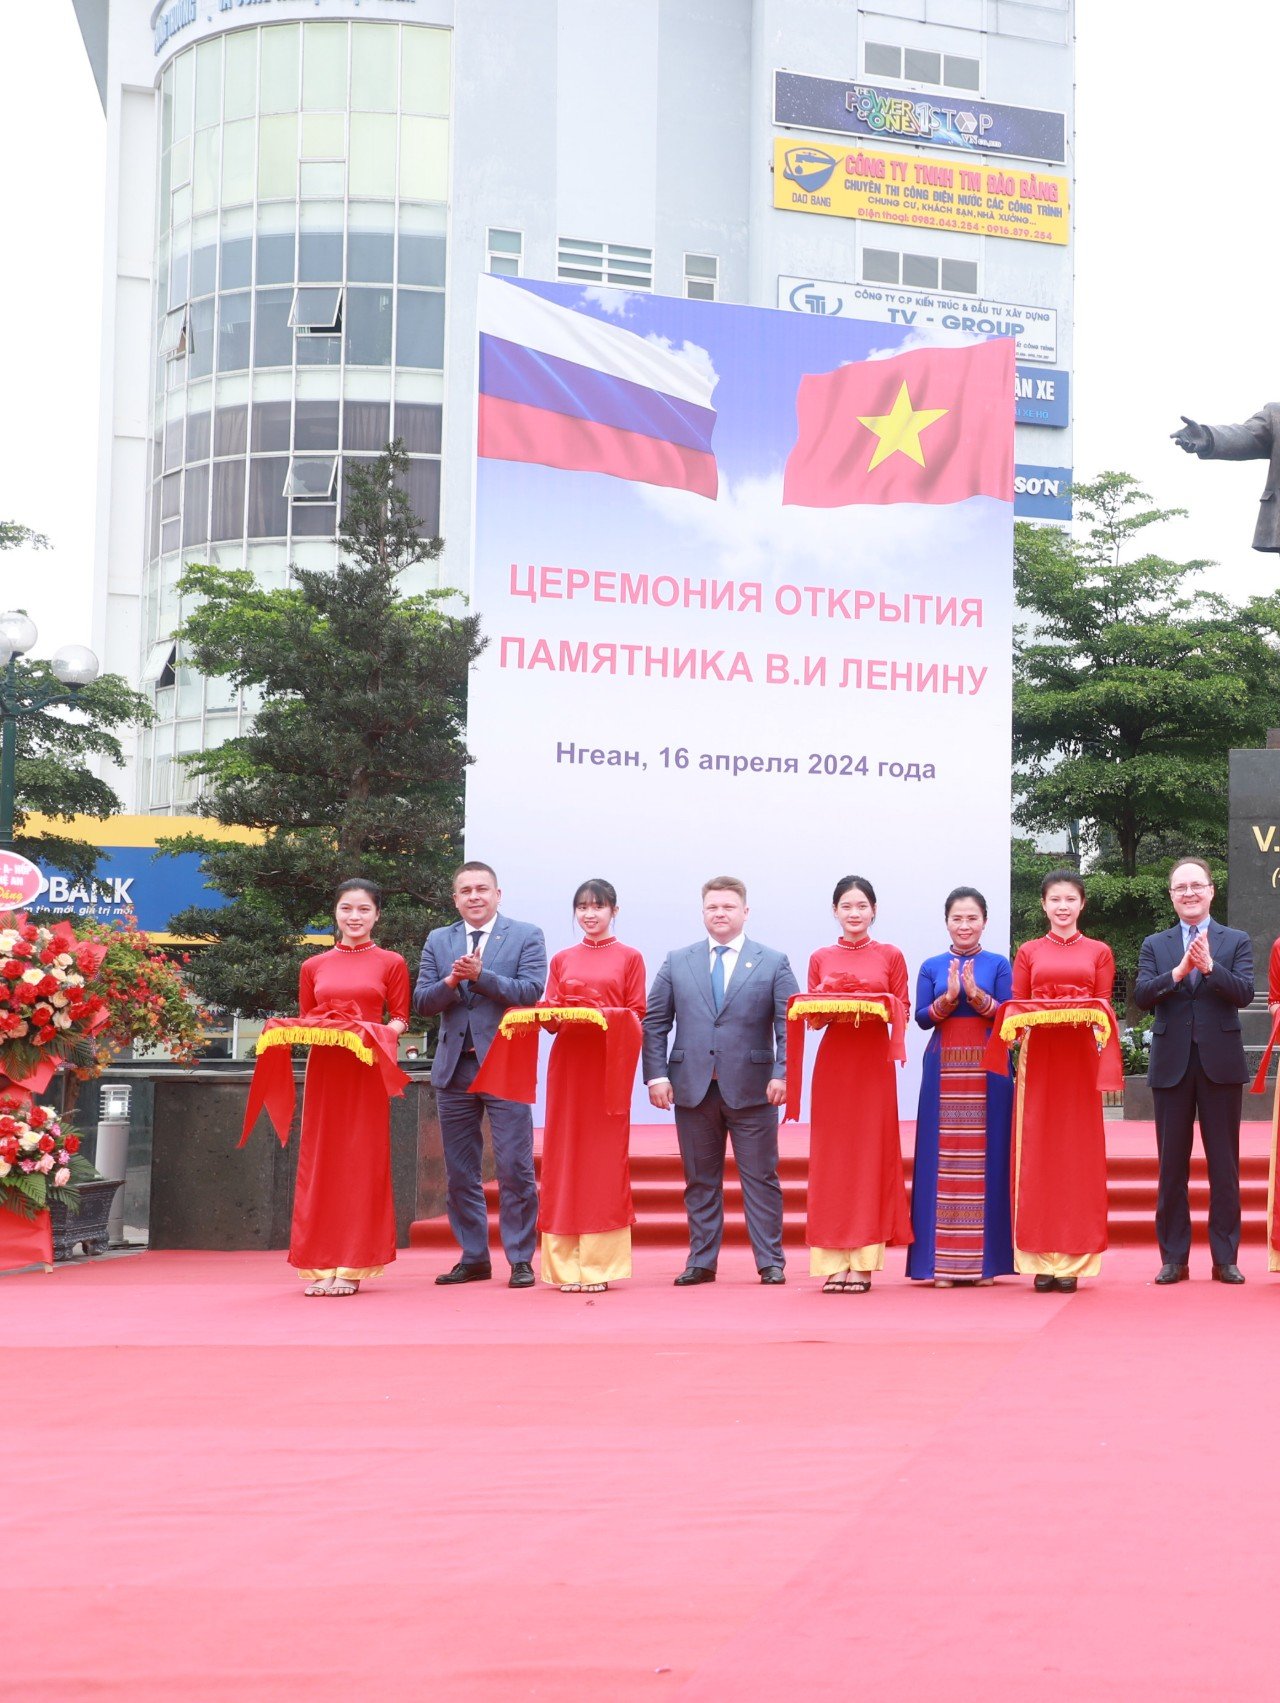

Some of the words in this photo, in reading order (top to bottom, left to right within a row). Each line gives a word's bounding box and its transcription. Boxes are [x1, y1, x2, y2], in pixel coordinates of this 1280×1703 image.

[845, 151, 885, 179] CÔNG
[890, 161, 908, 181] TY
[914, 163, 953, 189] TNHH
[959, 170, 981, 192] TM
[987, 172, 1015, 196] ĐÀO
[844, 179, 881, 194] CHUYÊN
[886, 184, 900, 196] THI
[904, 186, 928, 200] CÔNG
[933, 190, 953, 204] ĐIỆN
[958, 193, 982, 207] NƯỚC
[987, 198, 1004, 210] CÁC
[1008, 200, 1032, 214] CÔNG
[1037, 204, 1063, 218] TRÌNH
[868, 196, 900, 207] CHUNG
[922, 203, 952, 214] KHÁCH
[858, 207, 880, 219] Điện
[911, 214, 979, 231] 0982.043.254
[987, 224, 1053, 240] 0916.879.254
[854, 289, 882, 301] CÔNG
[885, 294, 896, 303] TY
[915, 296, 934, 307] KIẾN
[937, 299, 959, 310] TRÚC
[971, 302, 988, 314] ĐẦU
[992, 307, 1002, 316] TƯ
[1005, 308, 1022, 318] XÂY
[887, 308, 917, 324] TV
[941, 315, 1025, 336] GROUP
[1036, 379, 1055, 401] XE
[1014, 476, 1060, 497] SƠN
[509, 564, 763, 613] ЦЕРЕМОНИЯ
[775, 584, 984, 628] ОТКРЫТИЯ
[499, 636, 754, 683] ПАМЯТНИКА
[766, 653, 827, 686] В.И
[838, 658, 989, 696] ЛЕНИНУ
[556, 741, 648, 772] Нгеан,
[659, 746, 690, 770] 16
[698, 753, 799, 777] апреля
[807, 753, 870, 777] 2024
[877, 758, 937, 783] года
